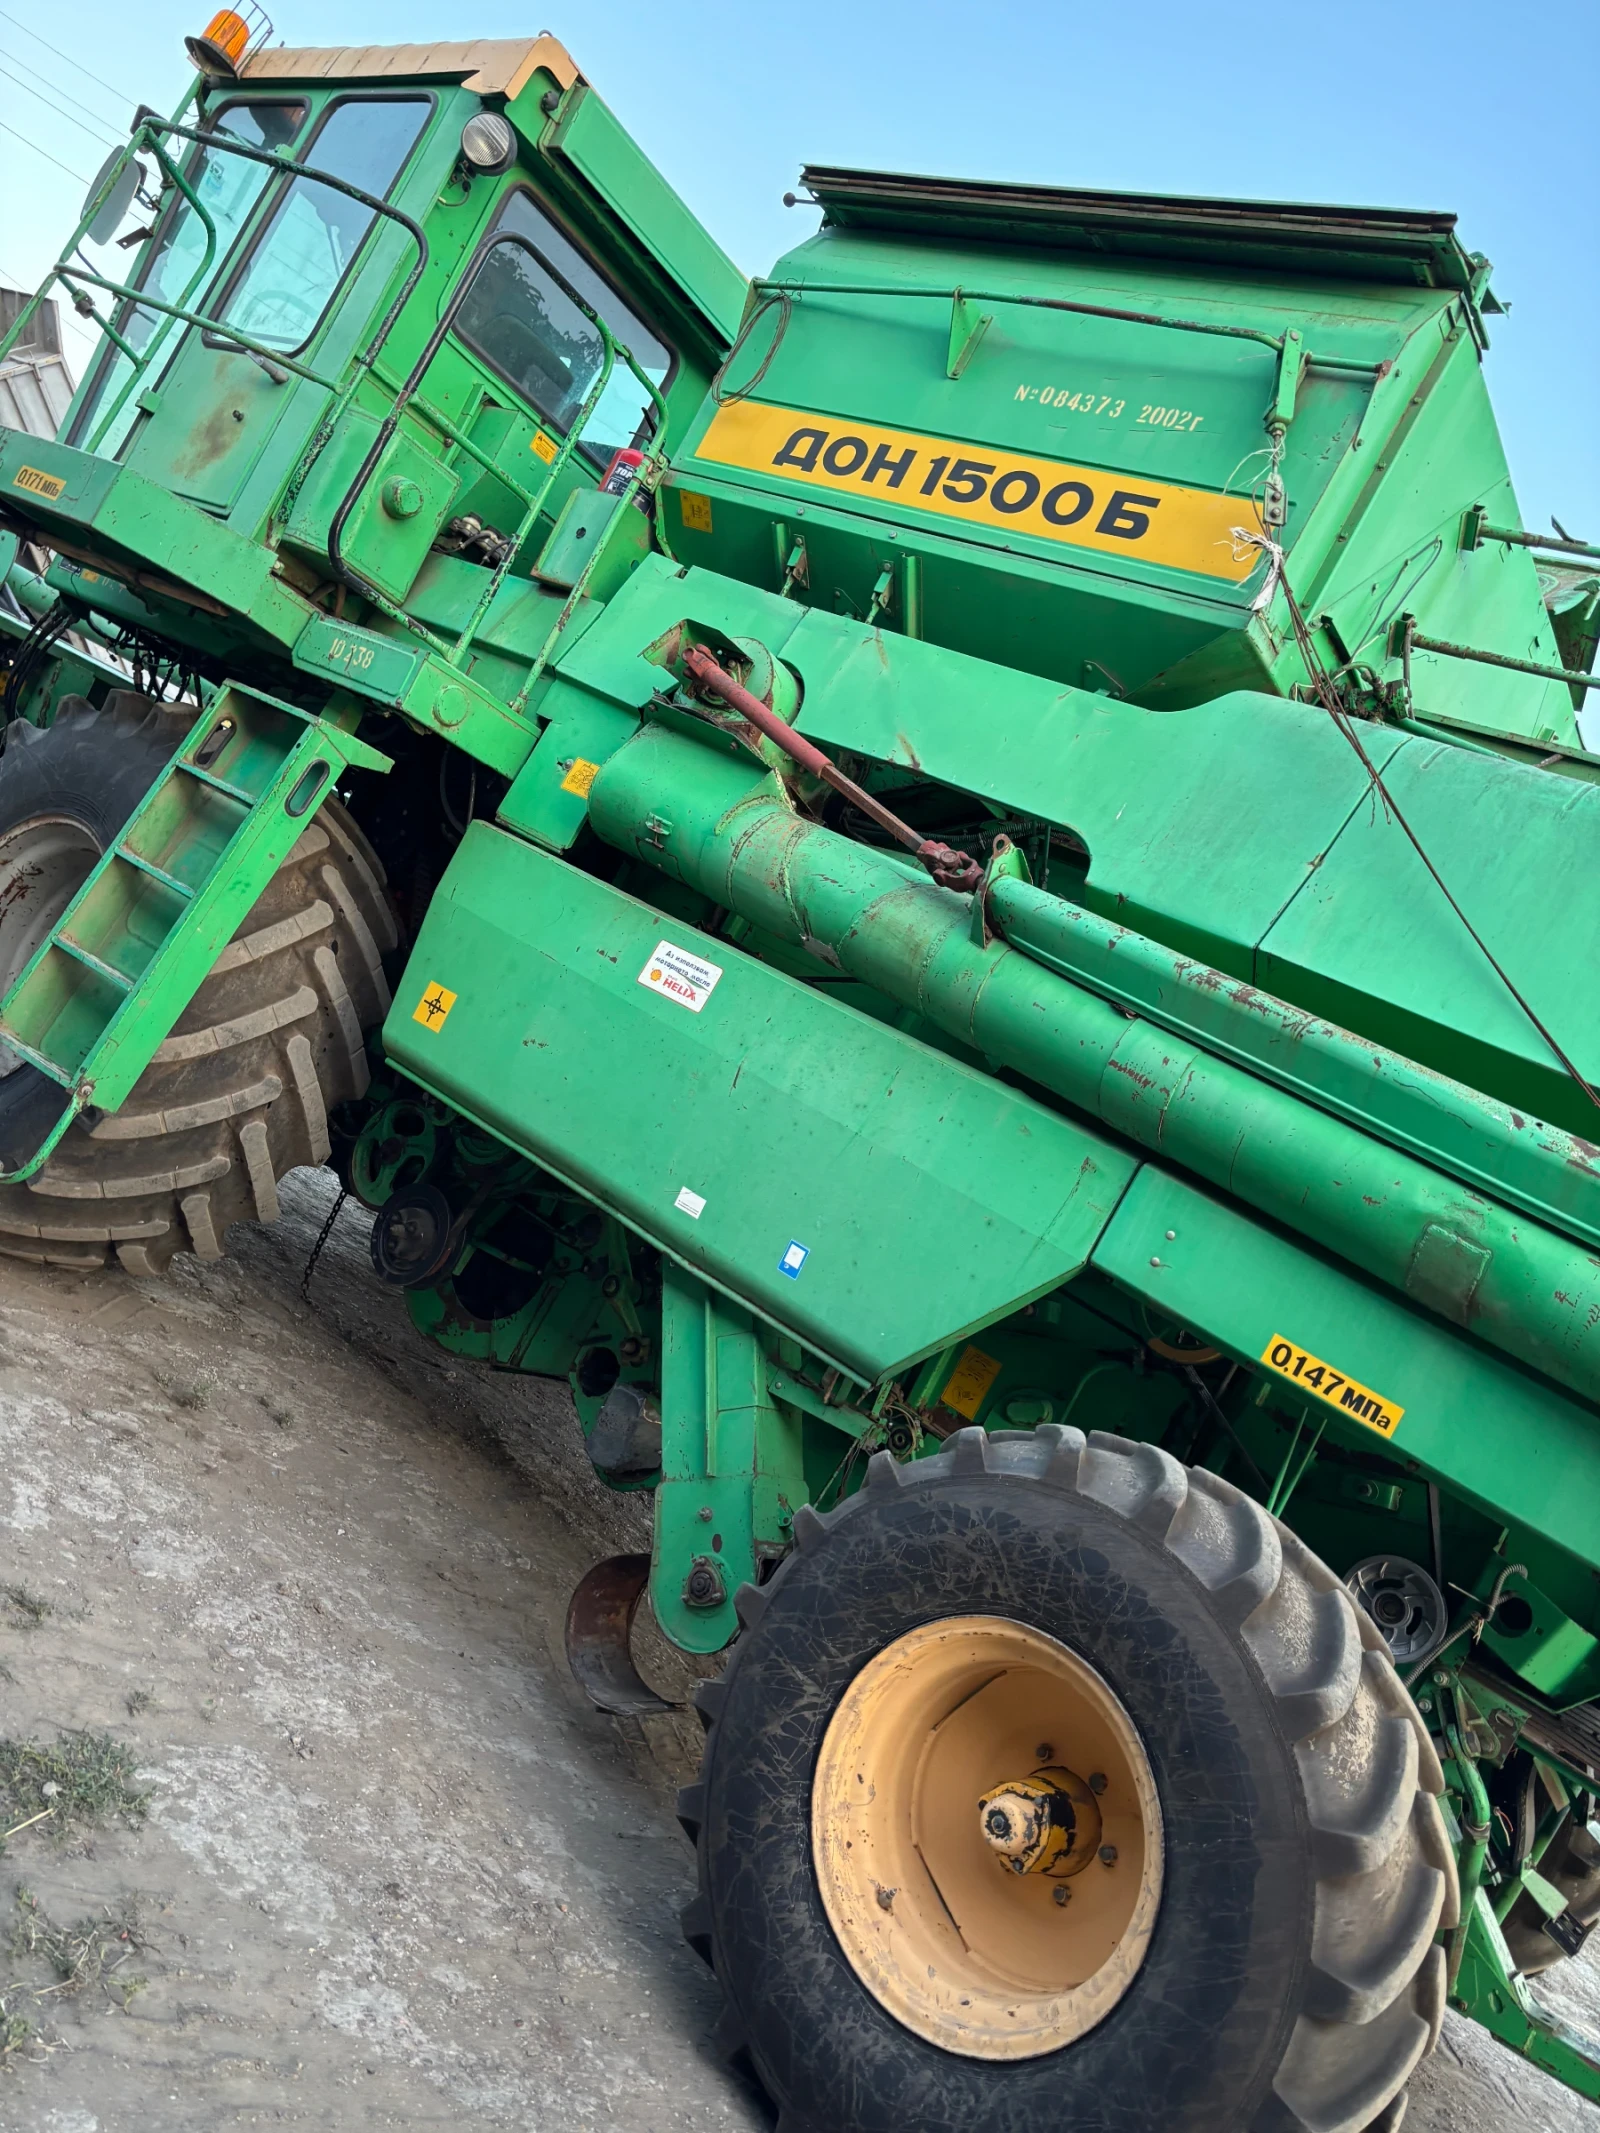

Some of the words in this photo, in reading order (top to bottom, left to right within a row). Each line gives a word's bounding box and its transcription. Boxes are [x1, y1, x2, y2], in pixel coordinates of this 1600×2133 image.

[1136, 404, 1205, 432] 2002г
[772, 427, 918, 490] ДОН
[662, 978, 697, 1002] HELIX
[1339, 1386, 1391, 1431] МПа
